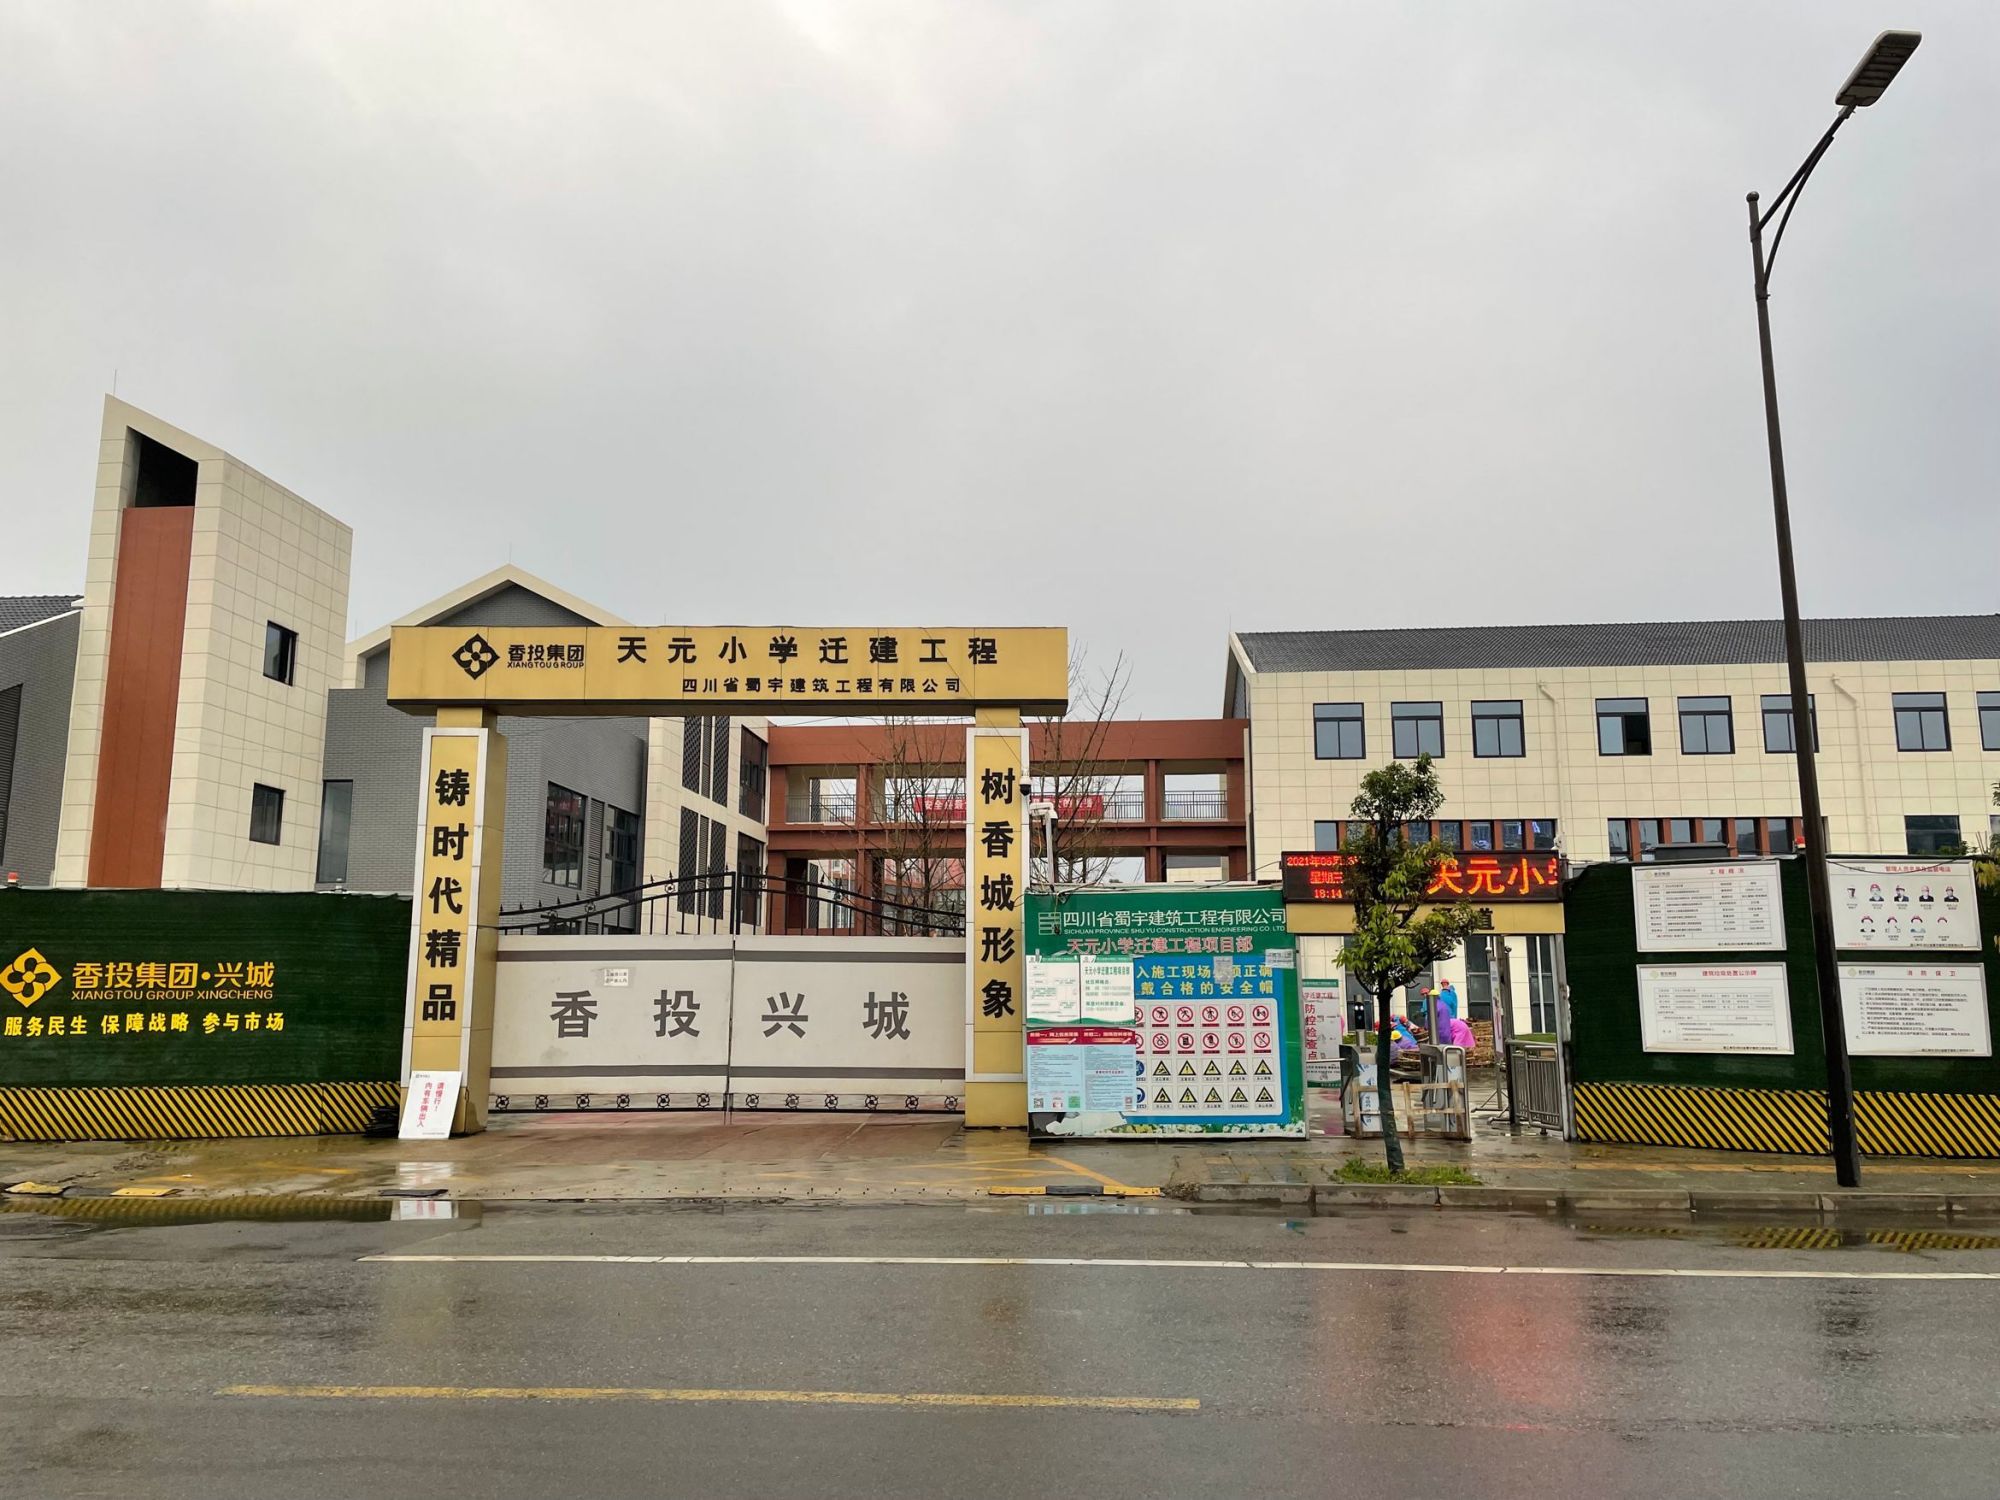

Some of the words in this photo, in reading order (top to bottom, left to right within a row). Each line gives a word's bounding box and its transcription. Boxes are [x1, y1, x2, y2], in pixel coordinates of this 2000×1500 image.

[508, 644, 585, 662] 香投集团
[617, 636, 997, 664] 天元小学迁建工程
[682, 678, 960, 693] 四川省蜀宇建筑工程有限公司
[423, 768, 470, 1021] 铸时代精品
[980, 767, 1015, 1016] 树香城形象
[1314, 889, 1342, 898] 18:14
[1063, 908, 1286, 927] 四川省蜀宇建筑工程有限公司
[1066, 936, 1253, 955] 天元小学迁建工程项目部
[71, 990, 143, 1000] XIANGTOU
[146, 990, 194, 1000] GROUP
[197, 989, 273, 1000] XINGCHENG
[4, 1016, 88, 1036] 服务民生
[101, 1012, 190, 1034] 保障战略
[203, 1012, 284, 1034] 参与市场
[550, 989, 911, 1040] 香投兴城
[1304, 1003, 1318, 1060] 防控检查点
